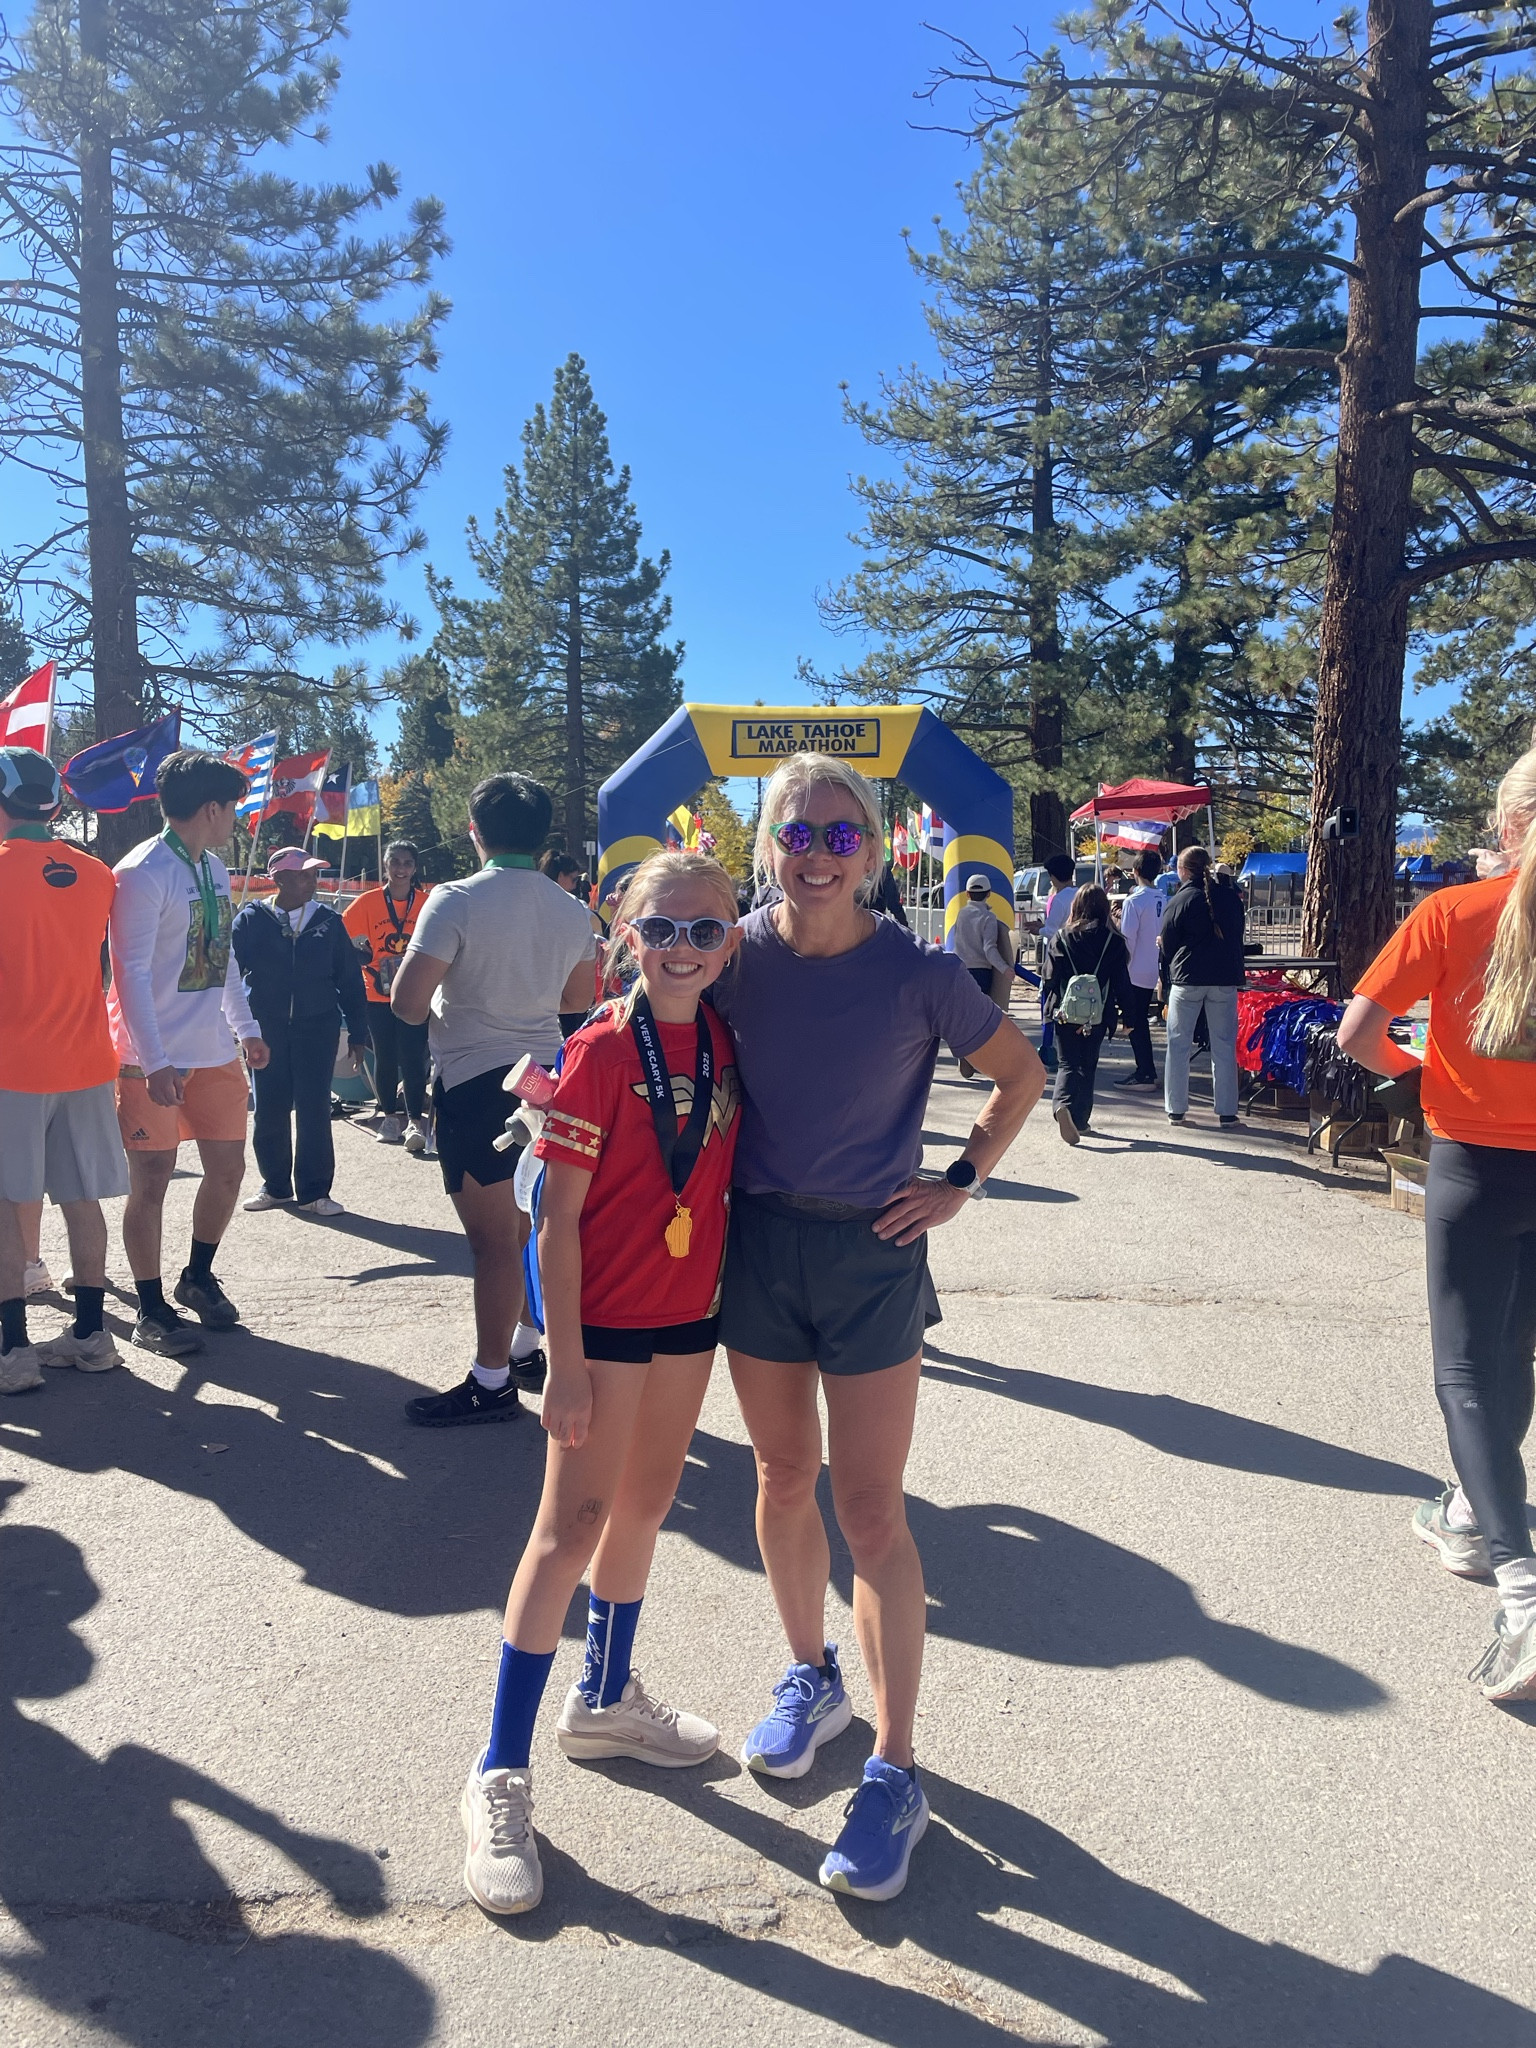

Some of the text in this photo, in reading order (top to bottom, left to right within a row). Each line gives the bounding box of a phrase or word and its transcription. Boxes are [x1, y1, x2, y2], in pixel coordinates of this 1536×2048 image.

[747, 723, 866, 739] LAKE TAHOE
[758, 738, 856, 752] MARATHON
[636, 1015, 665, 1099] A VERY SCARY 5K
[702, 1051, 710, 1079] 2025
